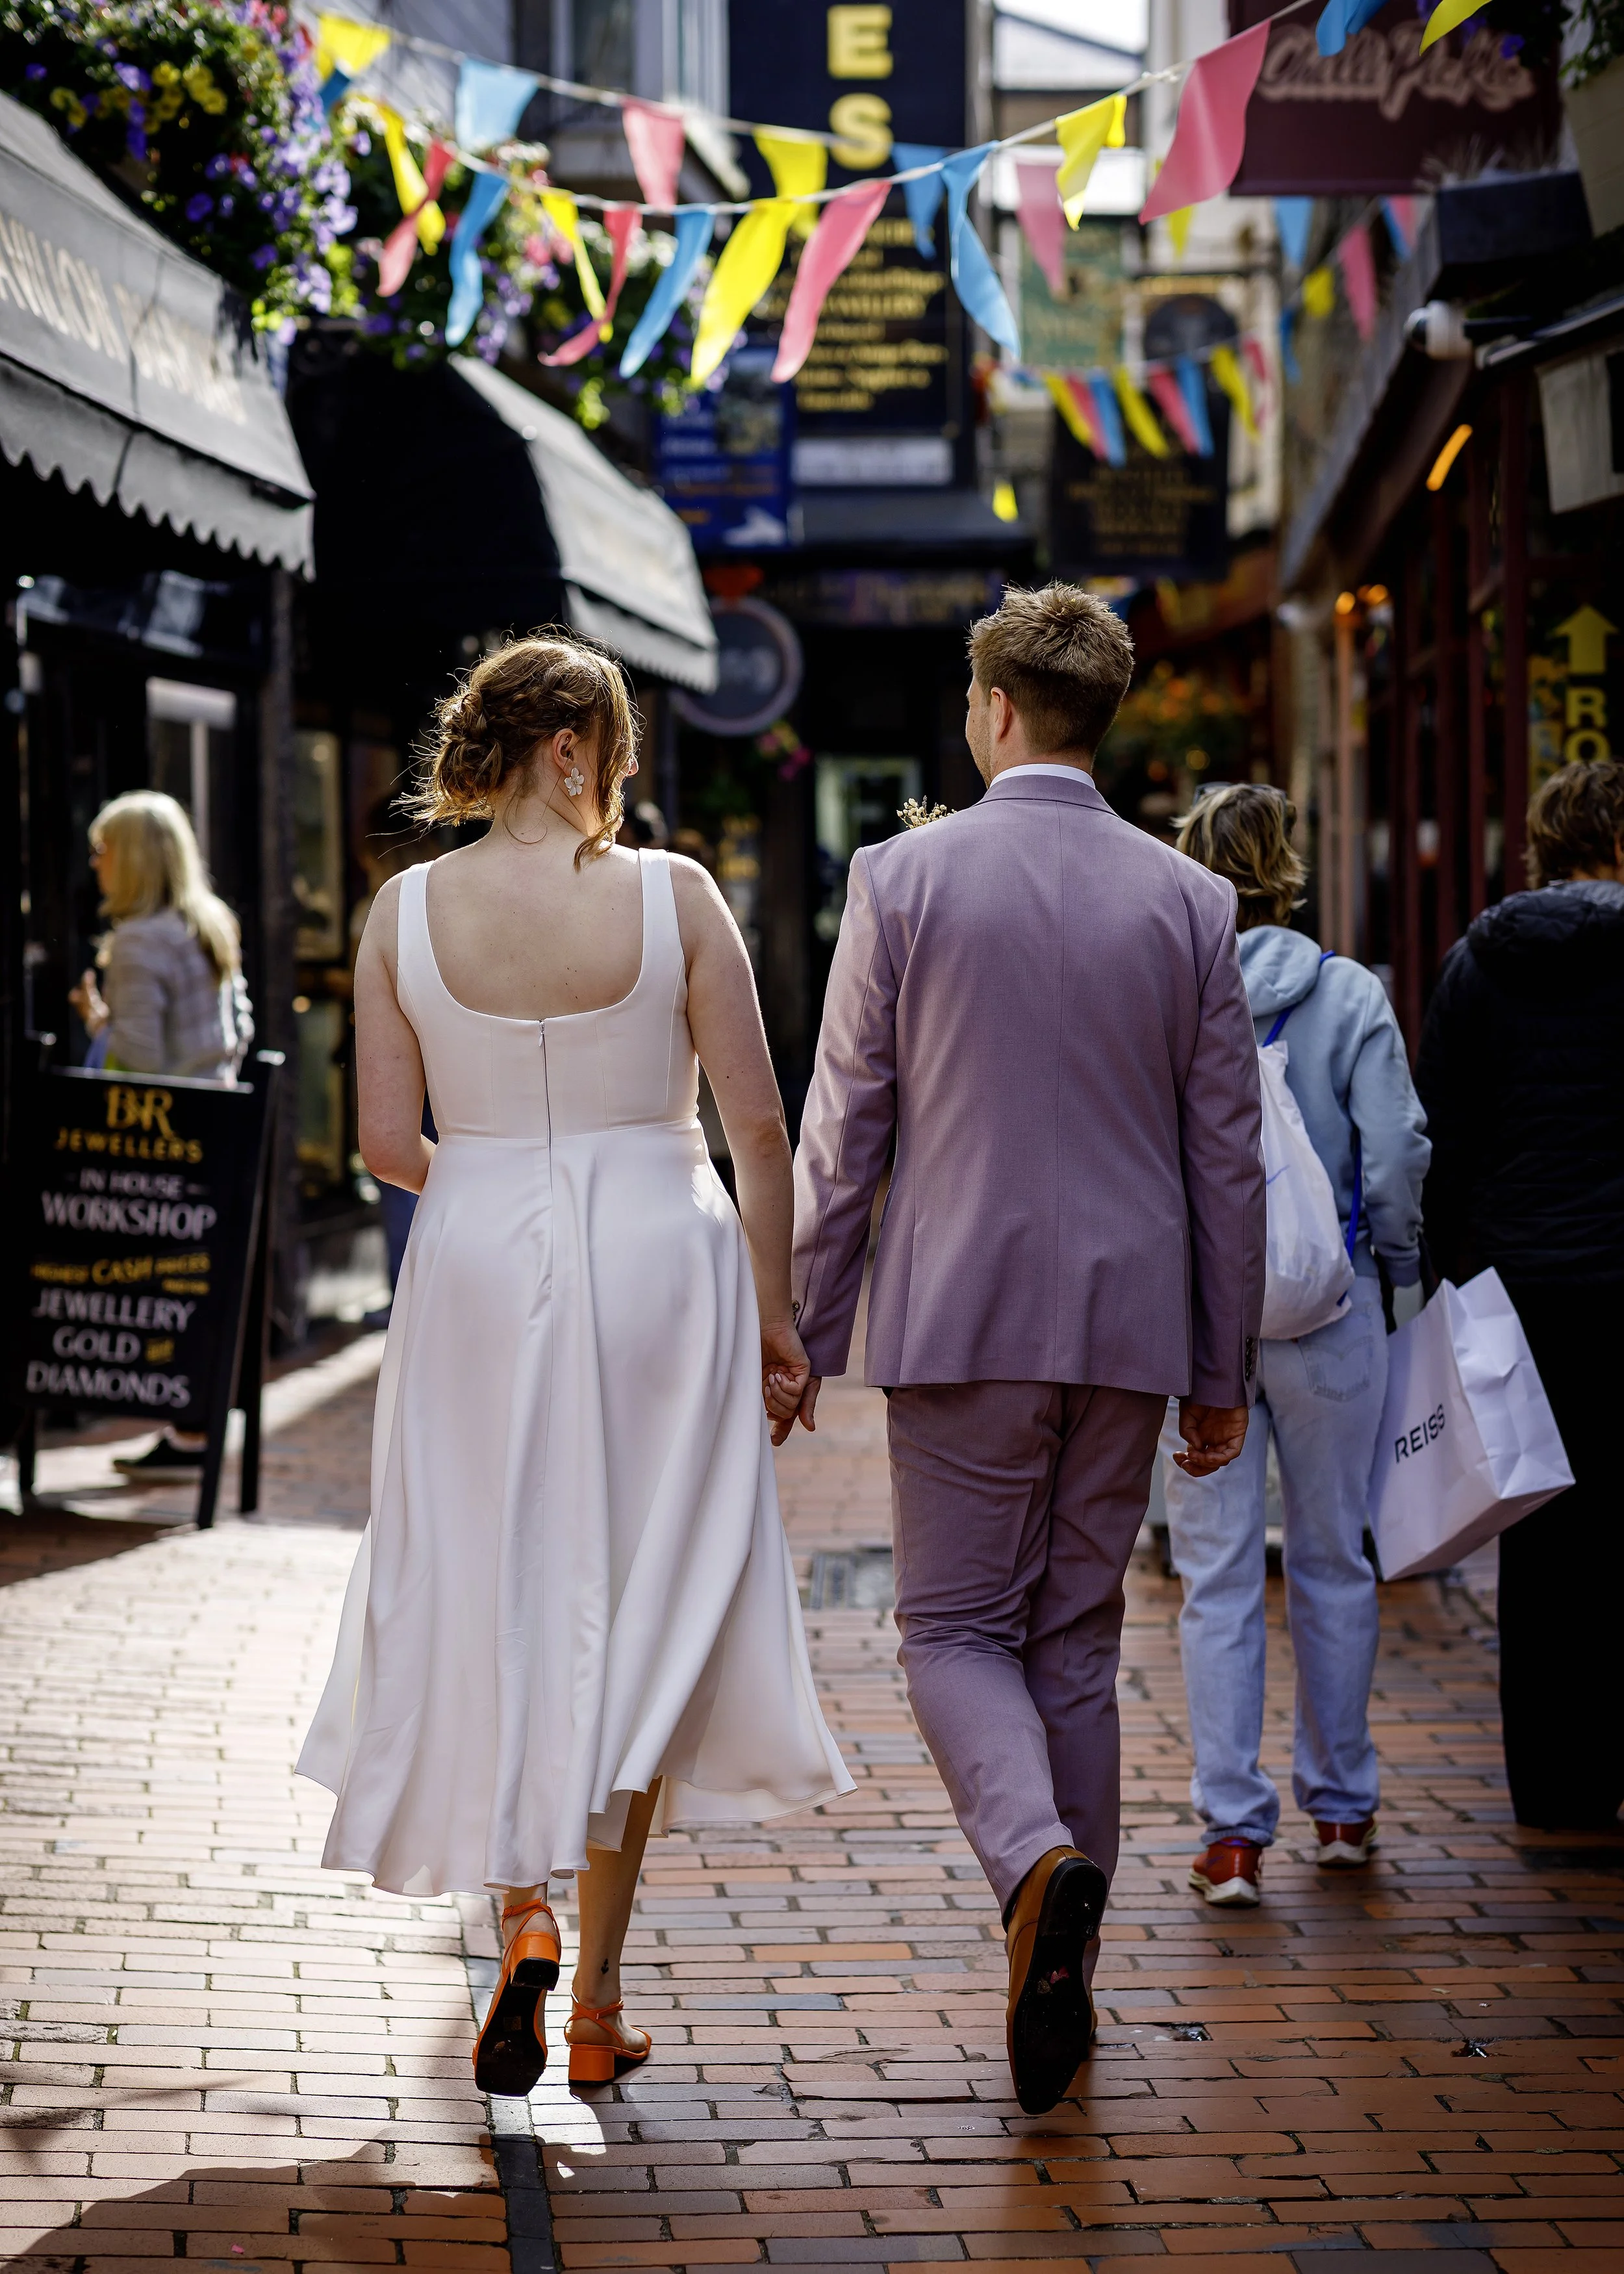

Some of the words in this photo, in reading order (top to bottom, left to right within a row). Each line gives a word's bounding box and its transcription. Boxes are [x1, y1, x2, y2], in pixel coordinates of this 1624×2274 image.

[54, 1127, 202, 1163] JEWELLERS
[79, 1168, 106, 1192] IN
[109, 1171, 184, 1200] HOUSE
[41, 1190, 218, 1240] WORKSHOP
[92, 1256, 153, 1285] CASH
[32, 1288, 196, 1333] JEWELLERY
[53, 1325, 141, 1364] GOLD
[26, 1360, 191, 1409] DIAMONDS
[1395, 1403, 1445, 1463] REISS
